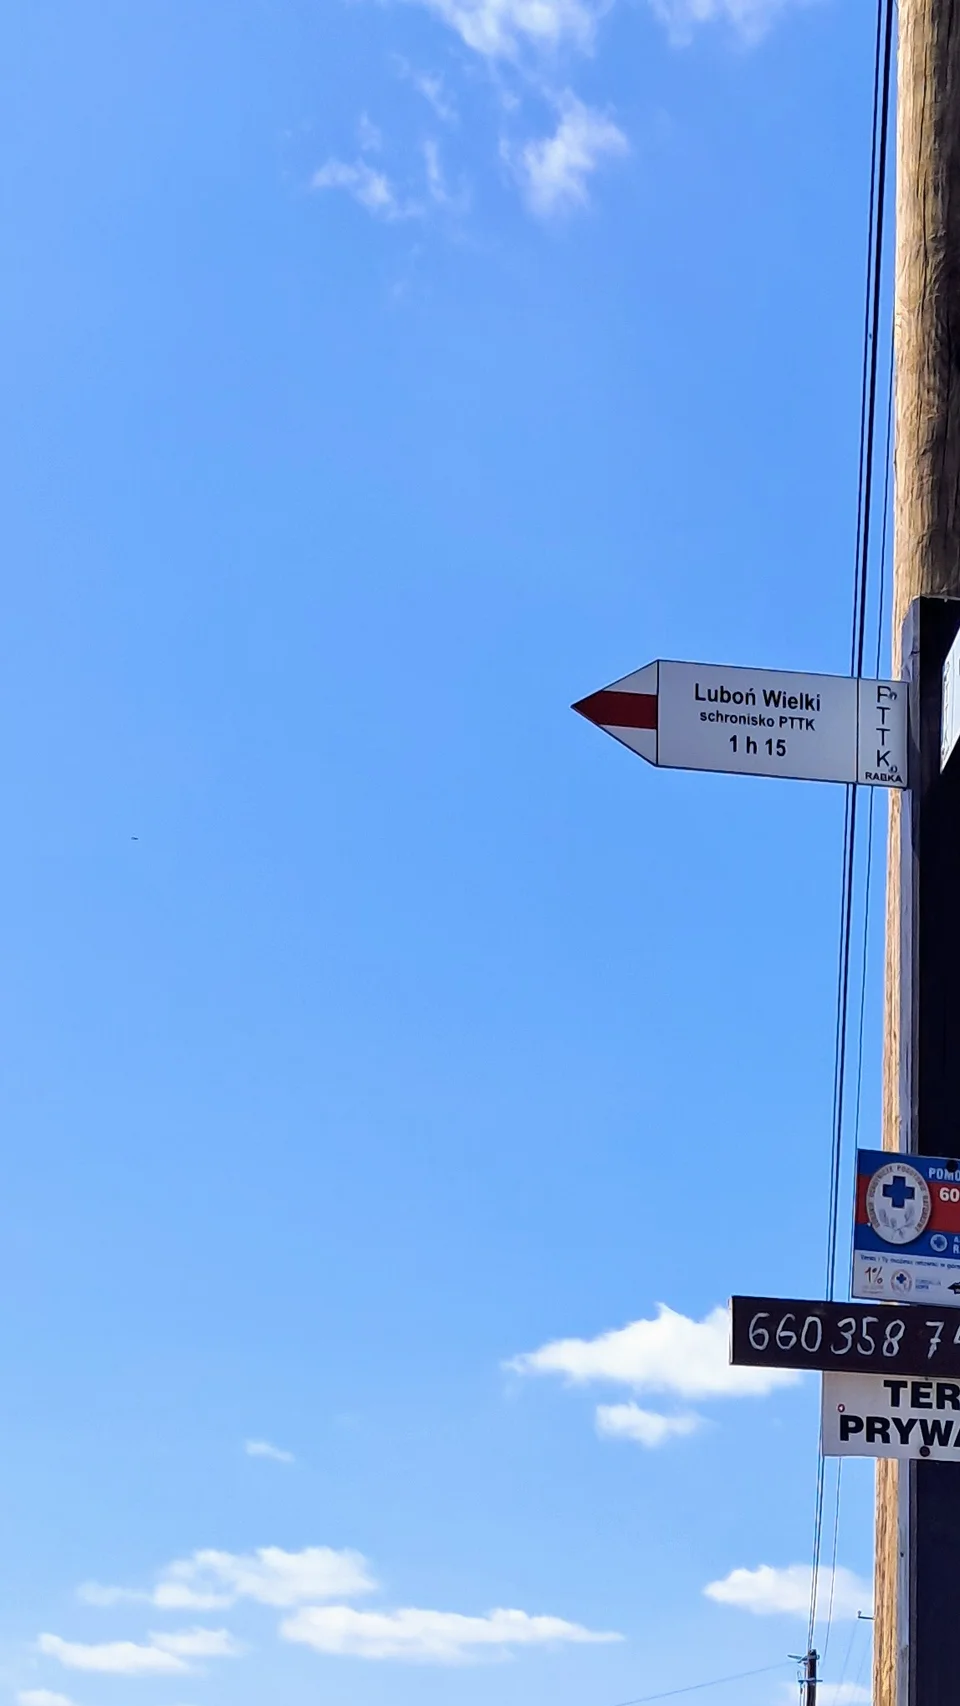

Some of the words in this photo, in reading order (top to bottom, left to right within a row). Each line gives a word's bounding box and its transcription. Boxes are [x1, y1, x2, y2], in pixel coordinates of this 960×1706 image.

[694, 682, 756, 706] Luboń
[762, 688, 821, 712] Wielki
[699, 709, 775, 728] schronisko
[778, 715, 816, 732] PTTK
[875, 685, 892, 768] PTTK
[729, 734, 738, 753] 1
[746, 736, 757, 755] h
[765, 738, 787, 757] 15
[864, 771, 903, 783] RABKA
[864, 1266, 884, 1285] 1%
[749, 1312, 823, 1352] 660
[830, 1315, 906, 1357] 358
